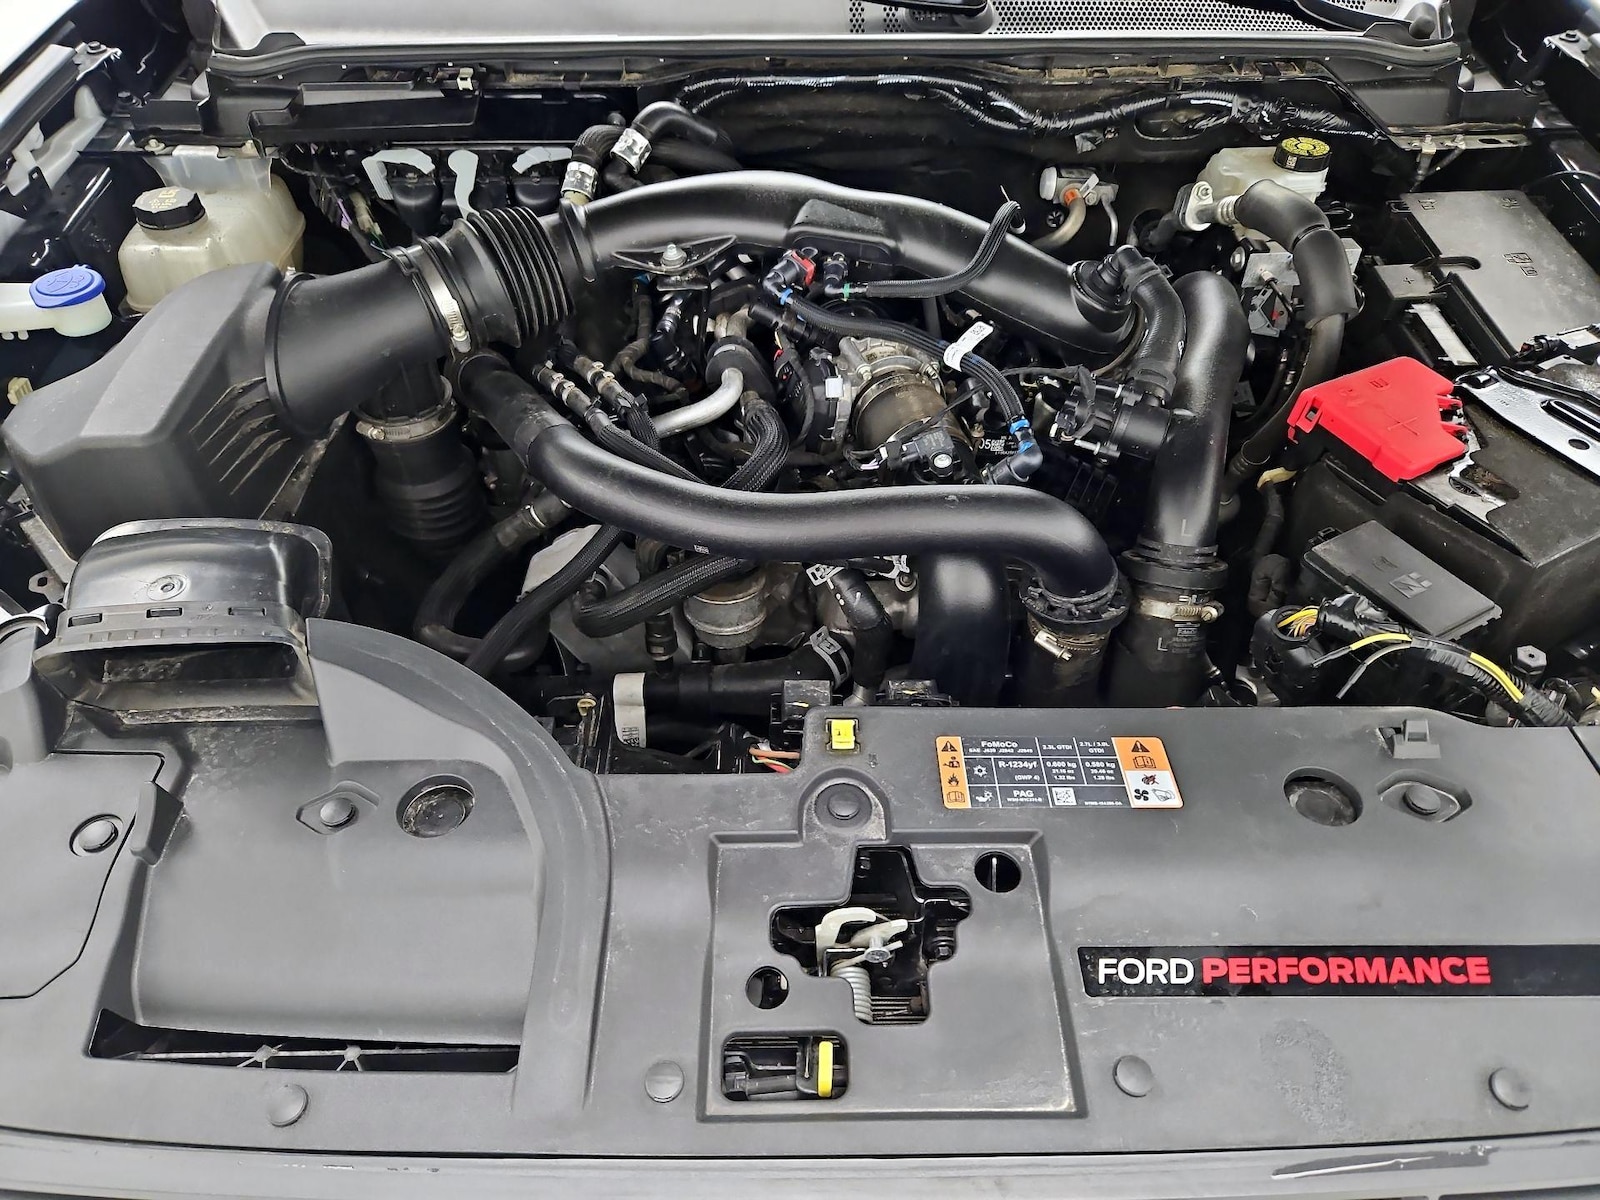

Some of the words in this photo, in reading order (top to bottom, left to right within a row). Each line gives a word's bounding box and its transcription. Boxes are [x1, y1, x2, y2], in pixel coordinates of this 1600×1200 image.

[1182, 519, 1192, 537] L
[1157, 637, 1168, 651] L
[998, 761, 1037, 770] R-1234yf
[1066, 761, 1077, 769] kg
[1105, 761, 1116, 769] kg
[1013, 790, 1034, 798] PAG
[1097, 958, 1195, 985] FORD
[1202, 957, 1491, 985] PERFORMANCE
